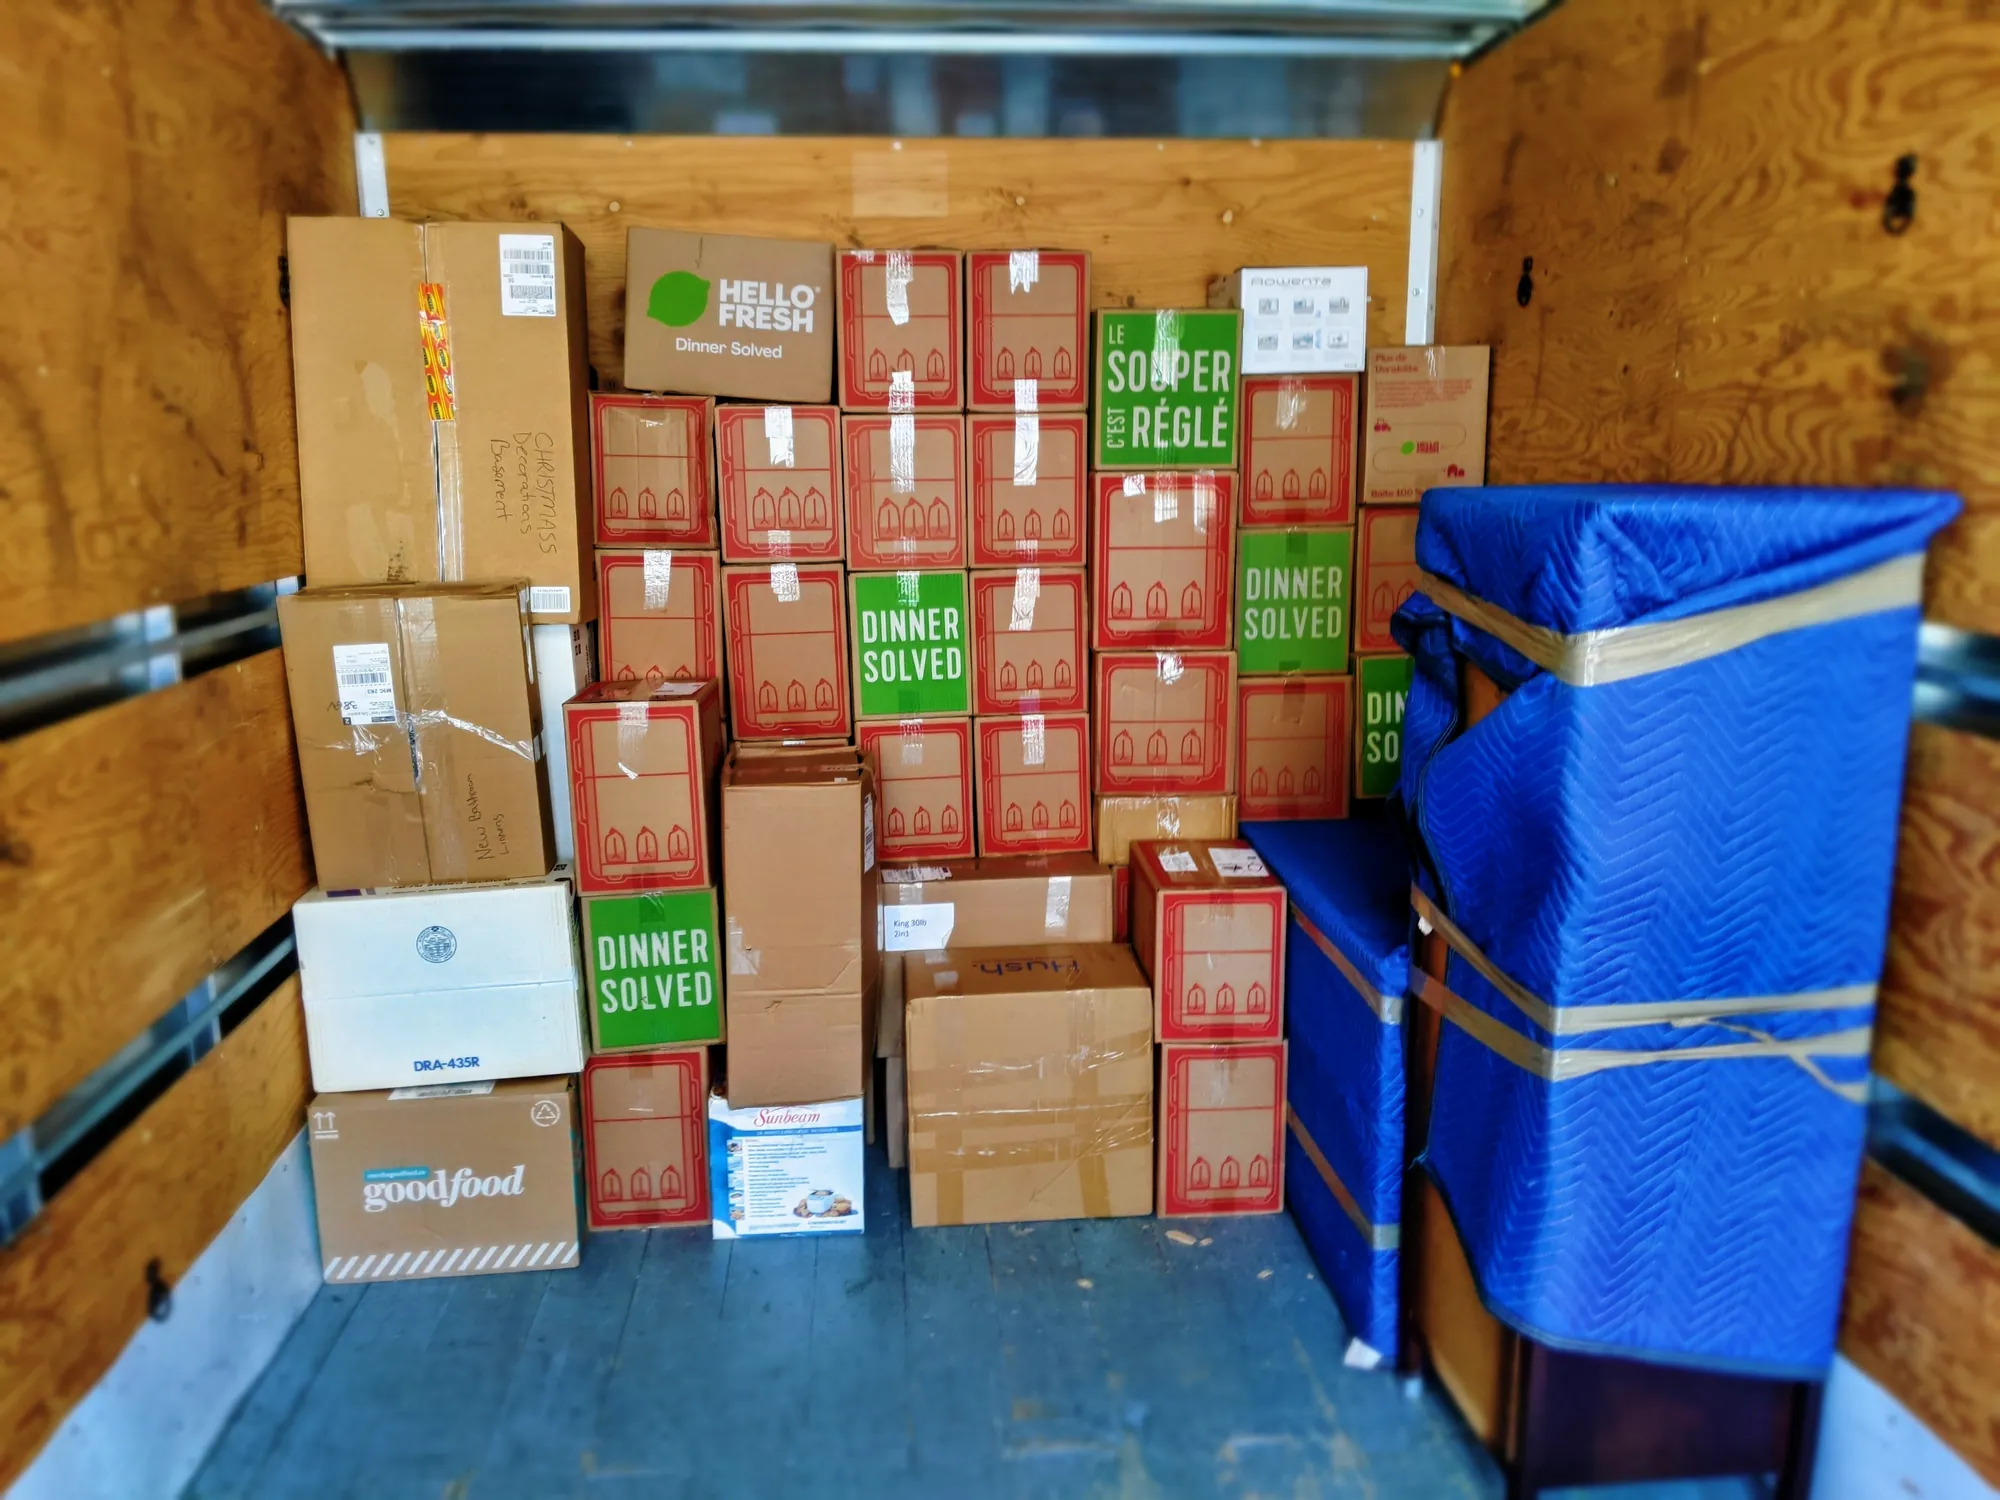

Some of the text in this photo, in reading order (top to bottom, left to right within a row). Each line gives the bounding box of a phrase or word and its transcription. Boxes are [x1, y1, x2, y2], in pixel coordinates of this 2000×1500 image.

[719, 278, 815, 309] HELLO
[718, 302, 814, 333] FRESH
[1108, 324, 1125, 345] LE
[675, 337, 783, 359] Dinner Solved
[1107, 349, 1231, 393] SOUPER
[1106, 406, 1126, 449] C'EST
[1131, 396, 1229, 449] RÉGLÉ
[490, 439, 513, 523] Basement
[513, 431, 536, 534] Decorations
[534, 432, 557, 554] CHRISTMASS
[1246, 565, 1343, 600] DINNER
[861, 607, 959, 643] DINNER
[1244, 605, 1342, 640] SOLVED
[863, 646, 962, 683] SOLVED
[474, 826, 496, 860] New
[893, 918, 927, 929] King 30lb
[893, 930, 910, 938] 2in1
[597, 928, 709, 971] DINNER
[600, 971, 713, 1014] SOLVED
[413, 1056, 481, 1072] DRA-435R
[753, 1108, 821, 1128] Sunbeam
[363, 1164, 526, 1213] goodfood
